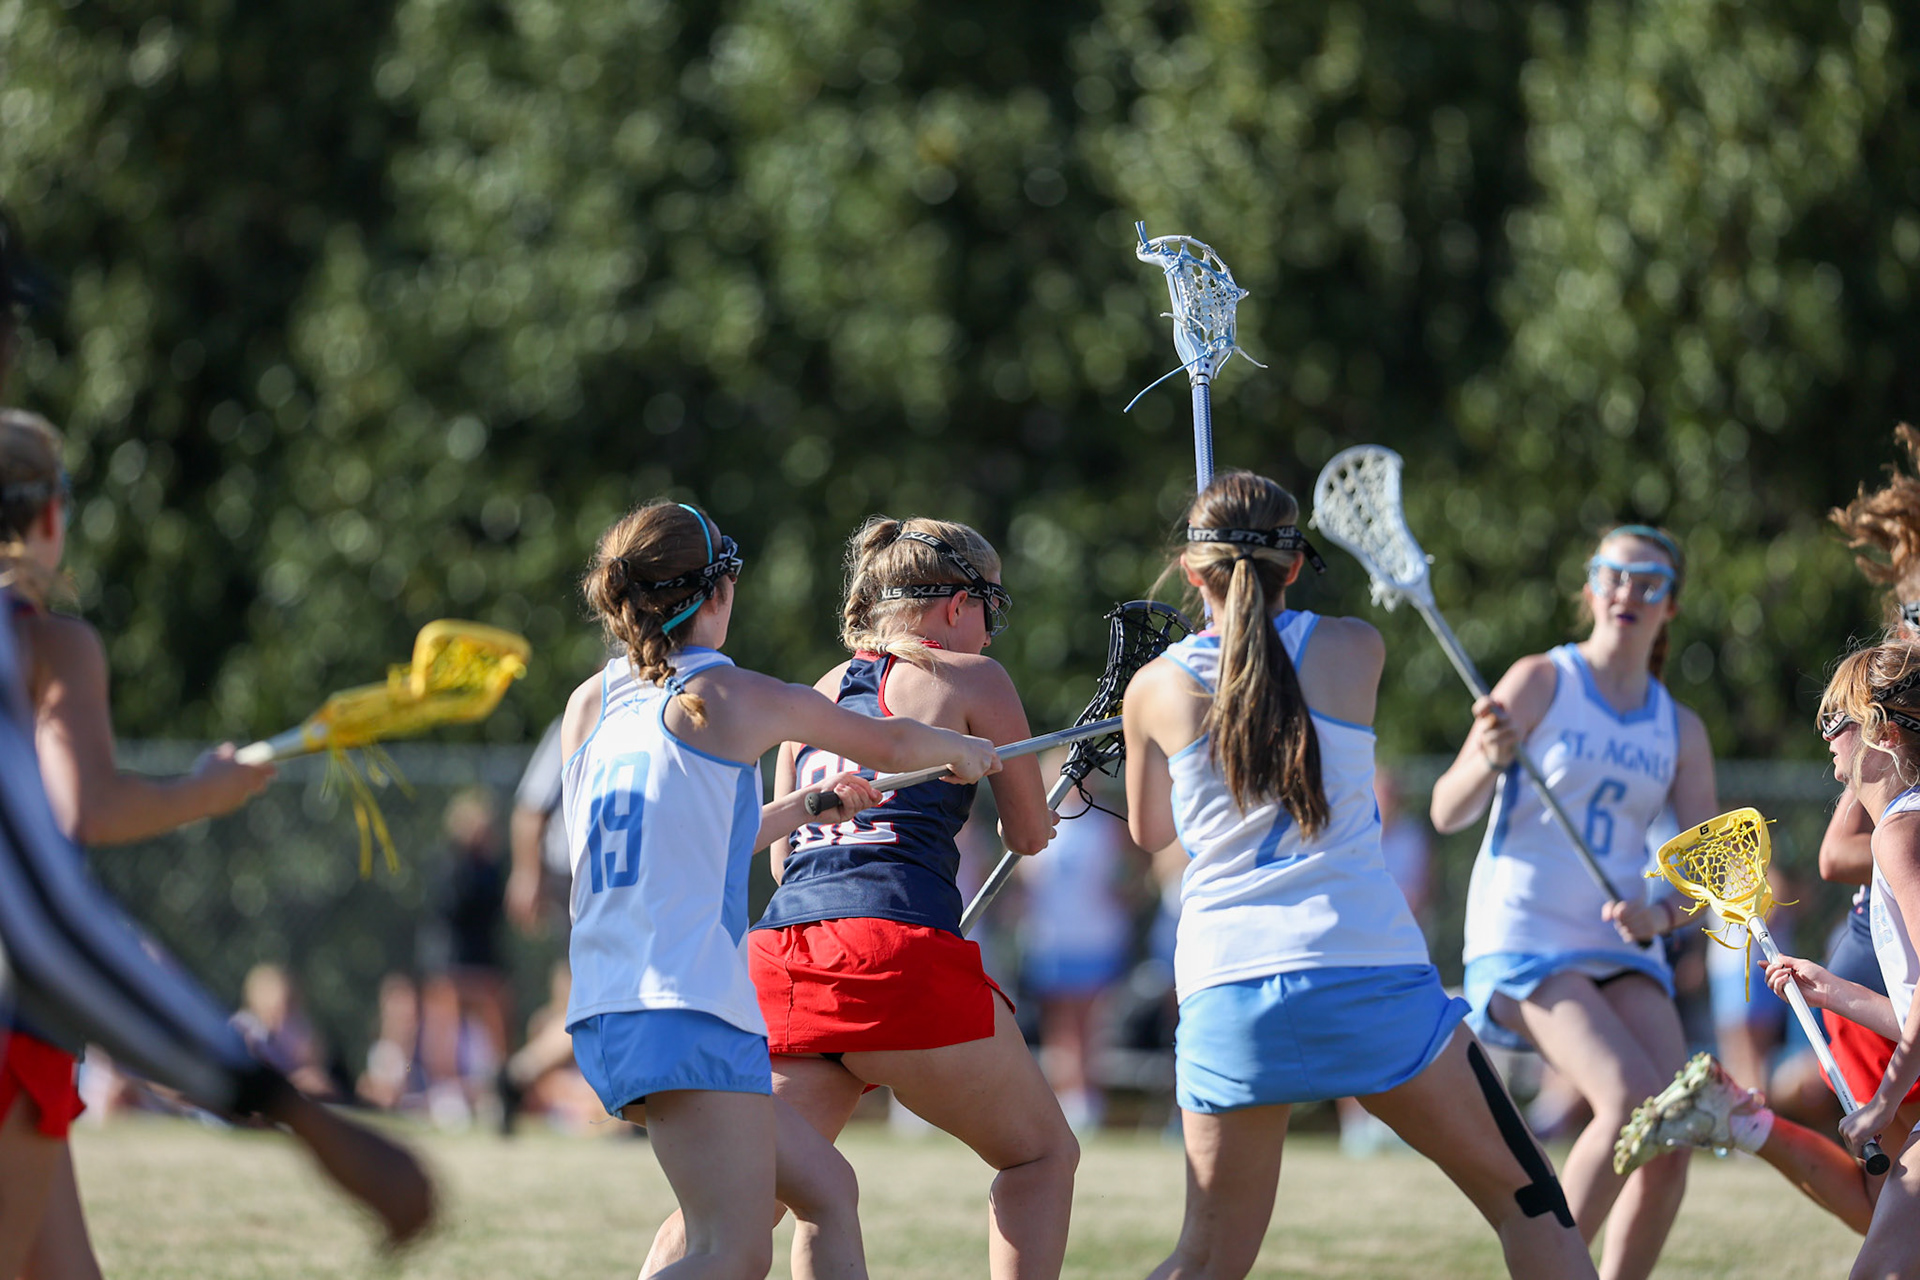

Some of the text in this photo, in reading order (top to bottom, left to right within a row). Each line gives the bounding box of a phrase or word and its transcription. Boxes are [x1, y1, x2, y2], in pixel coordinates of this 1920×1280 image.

[907, 531, 941, 546] STX
[1193, 529, 1219, 541] STX
[1229, 529, 1268, 545] STX
[704, 559, 728, 577] STX
[949, 549, 980, 580] STX
[913, 585, 954, 598] STX
[588, 750, 651, 895] 19
[1584, 777, 1627, 857] 6
[1699, 824, 1709, 836] G
